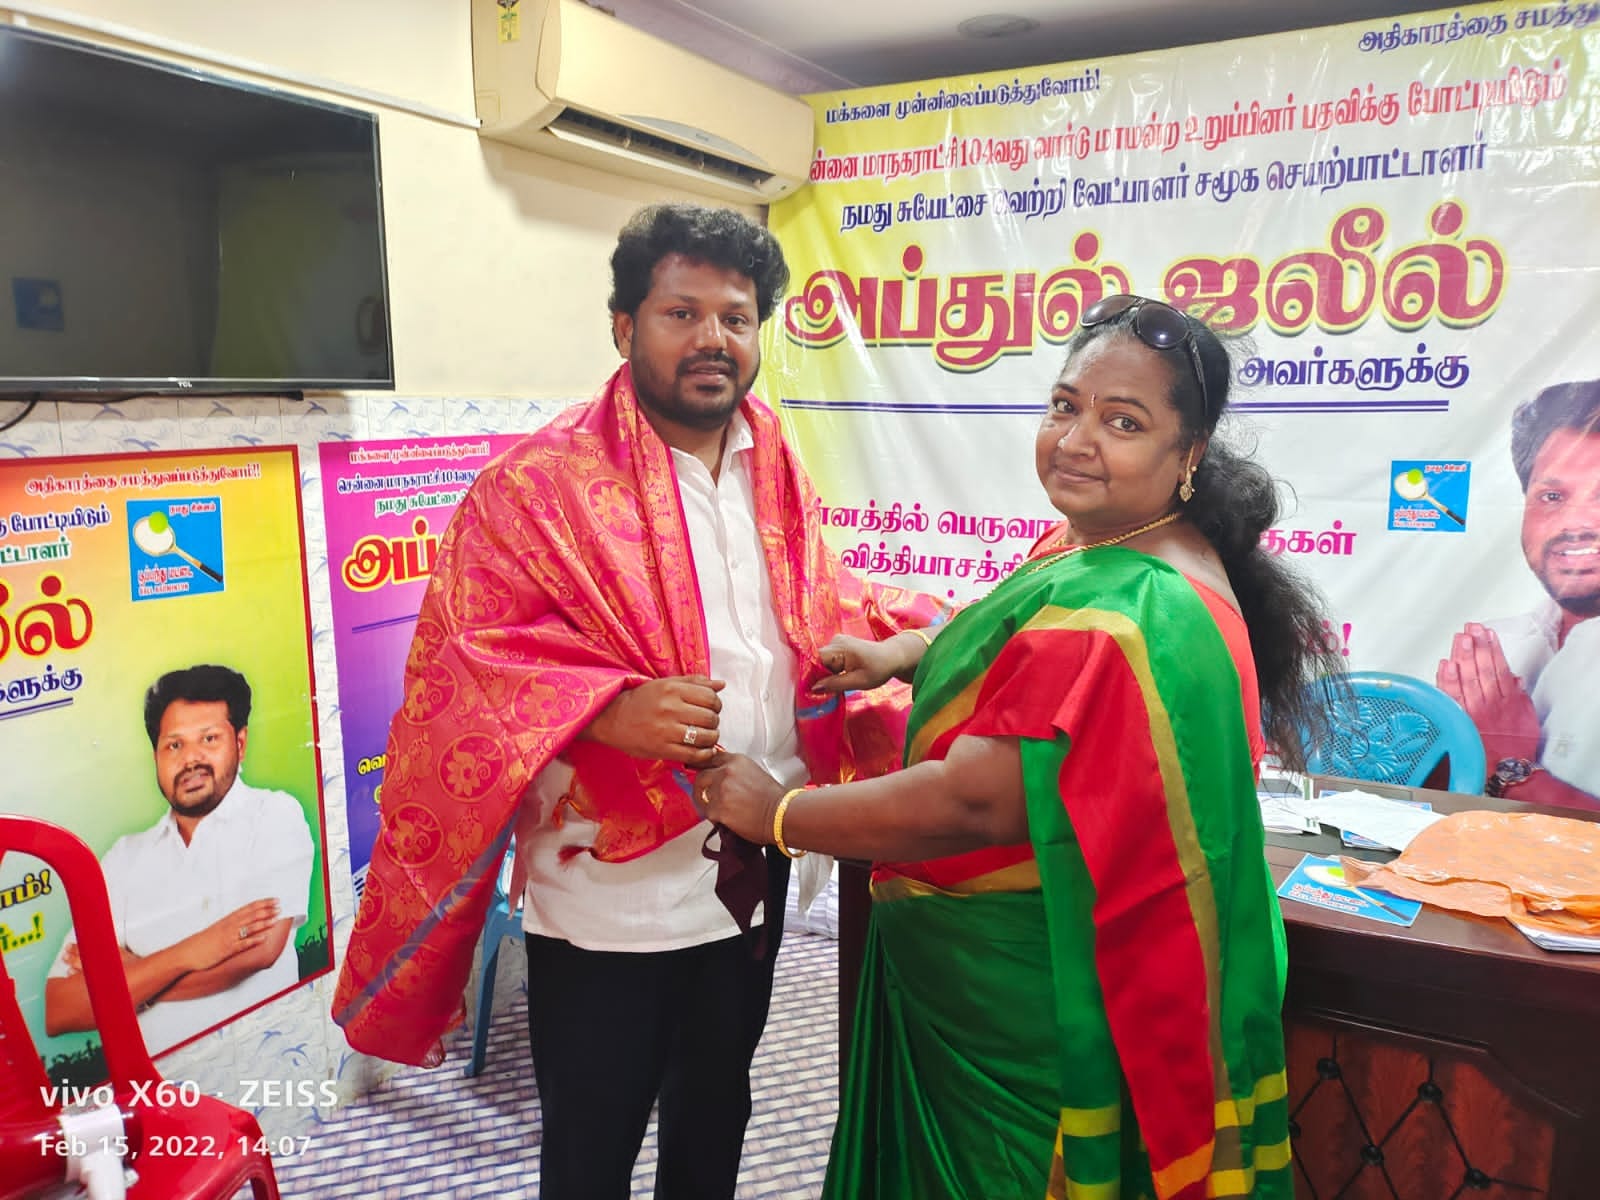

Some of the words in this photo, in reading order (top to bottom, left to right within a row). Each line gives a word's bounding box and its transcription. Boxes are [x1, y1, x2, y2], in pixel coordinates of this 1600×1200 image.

[1358, 11, 1508, 54] அதிகாரத்தை
[810, 149, 858, 182] ன்னை
[1034, 121, 1090, 160] வார்டு
[1094, 111, 1180, 154] மாமன்ற
[1185, 93, 1296, 151] உறுப்பினர்
[1302, 81, 1400, 133] பதவிக்கு
[1407, 58, 1567, 117] போட்டியிடும்
[826, 102, 891, 124] மக்களை
[895, 68, 1101, 121] முன்னிலைப்படுத்துவோம்!
[841, 202, 892, 233] நமது
[897, 193, 988, 223] சுயேட்சை
[1073, 162, 1190, 208] வேட்பாளர்
[1195, 166, 1260, 202] சமூக
[1266, 131, 1488, 196] செயற்பாட்டாளர்
[784, 231, 1131, 371] அப்துல்
[1162, 200, 1505, 333] ஜலீல்
[1238, 342, 1471, 391] அவர்களுக்கு
[27, 473, 117, 496] அதிகாரத்தை
[11, 504, 111, 533] போட்டியிடும்
